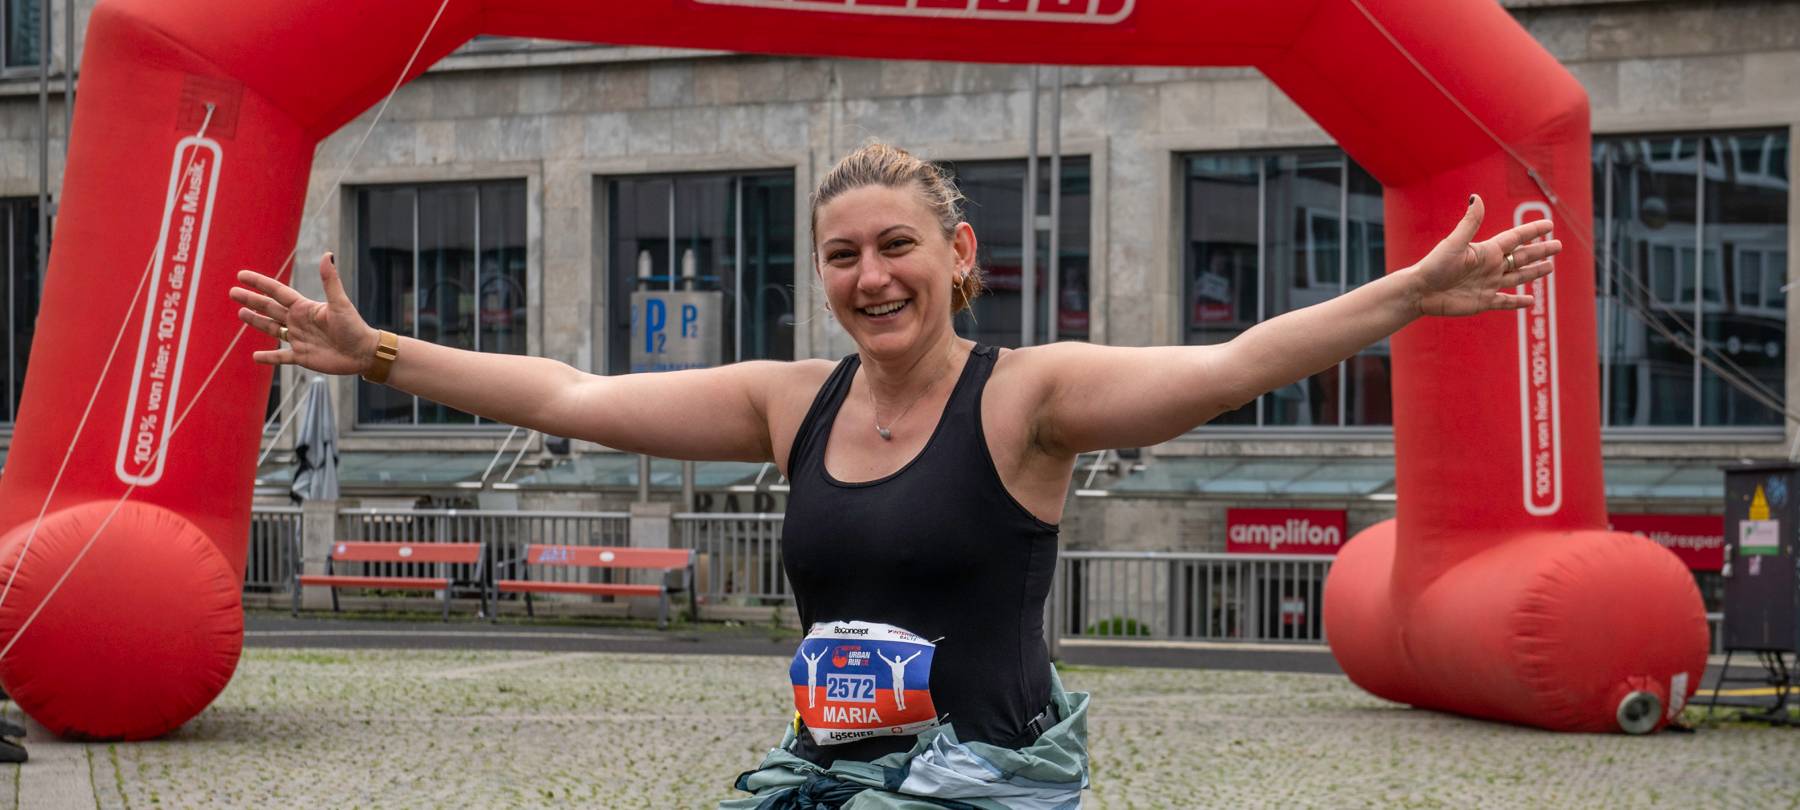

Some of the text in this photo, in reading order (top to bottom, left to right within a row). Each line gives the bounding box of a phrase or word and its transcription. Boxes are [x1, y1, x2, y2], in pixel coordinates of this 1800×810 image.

[134, 159, 206, 465] 100% von hier. 100% die beste Musik.
[1532, 316, 1546, 340] die
[1532, 340, 1547, 388] 100%
[1535, 387, 1549, 420] hier.
[1538, 421, 1549, 449] von
[1536, 451, 1550, 497] 100%
[1229, 518, 1340, 551] amplifon
[1650, 531, 1725, 551] Hörexper
[834, 626, 869, 636] BoConcept
[847, 658, 862, 666] RUN
[848, 651, 871, 659] URBAN
[828, 677, 875, 699] 2572
[823, 705, 883, 725] MARIA
[829, 730, 874, 741] LÖSCHER
